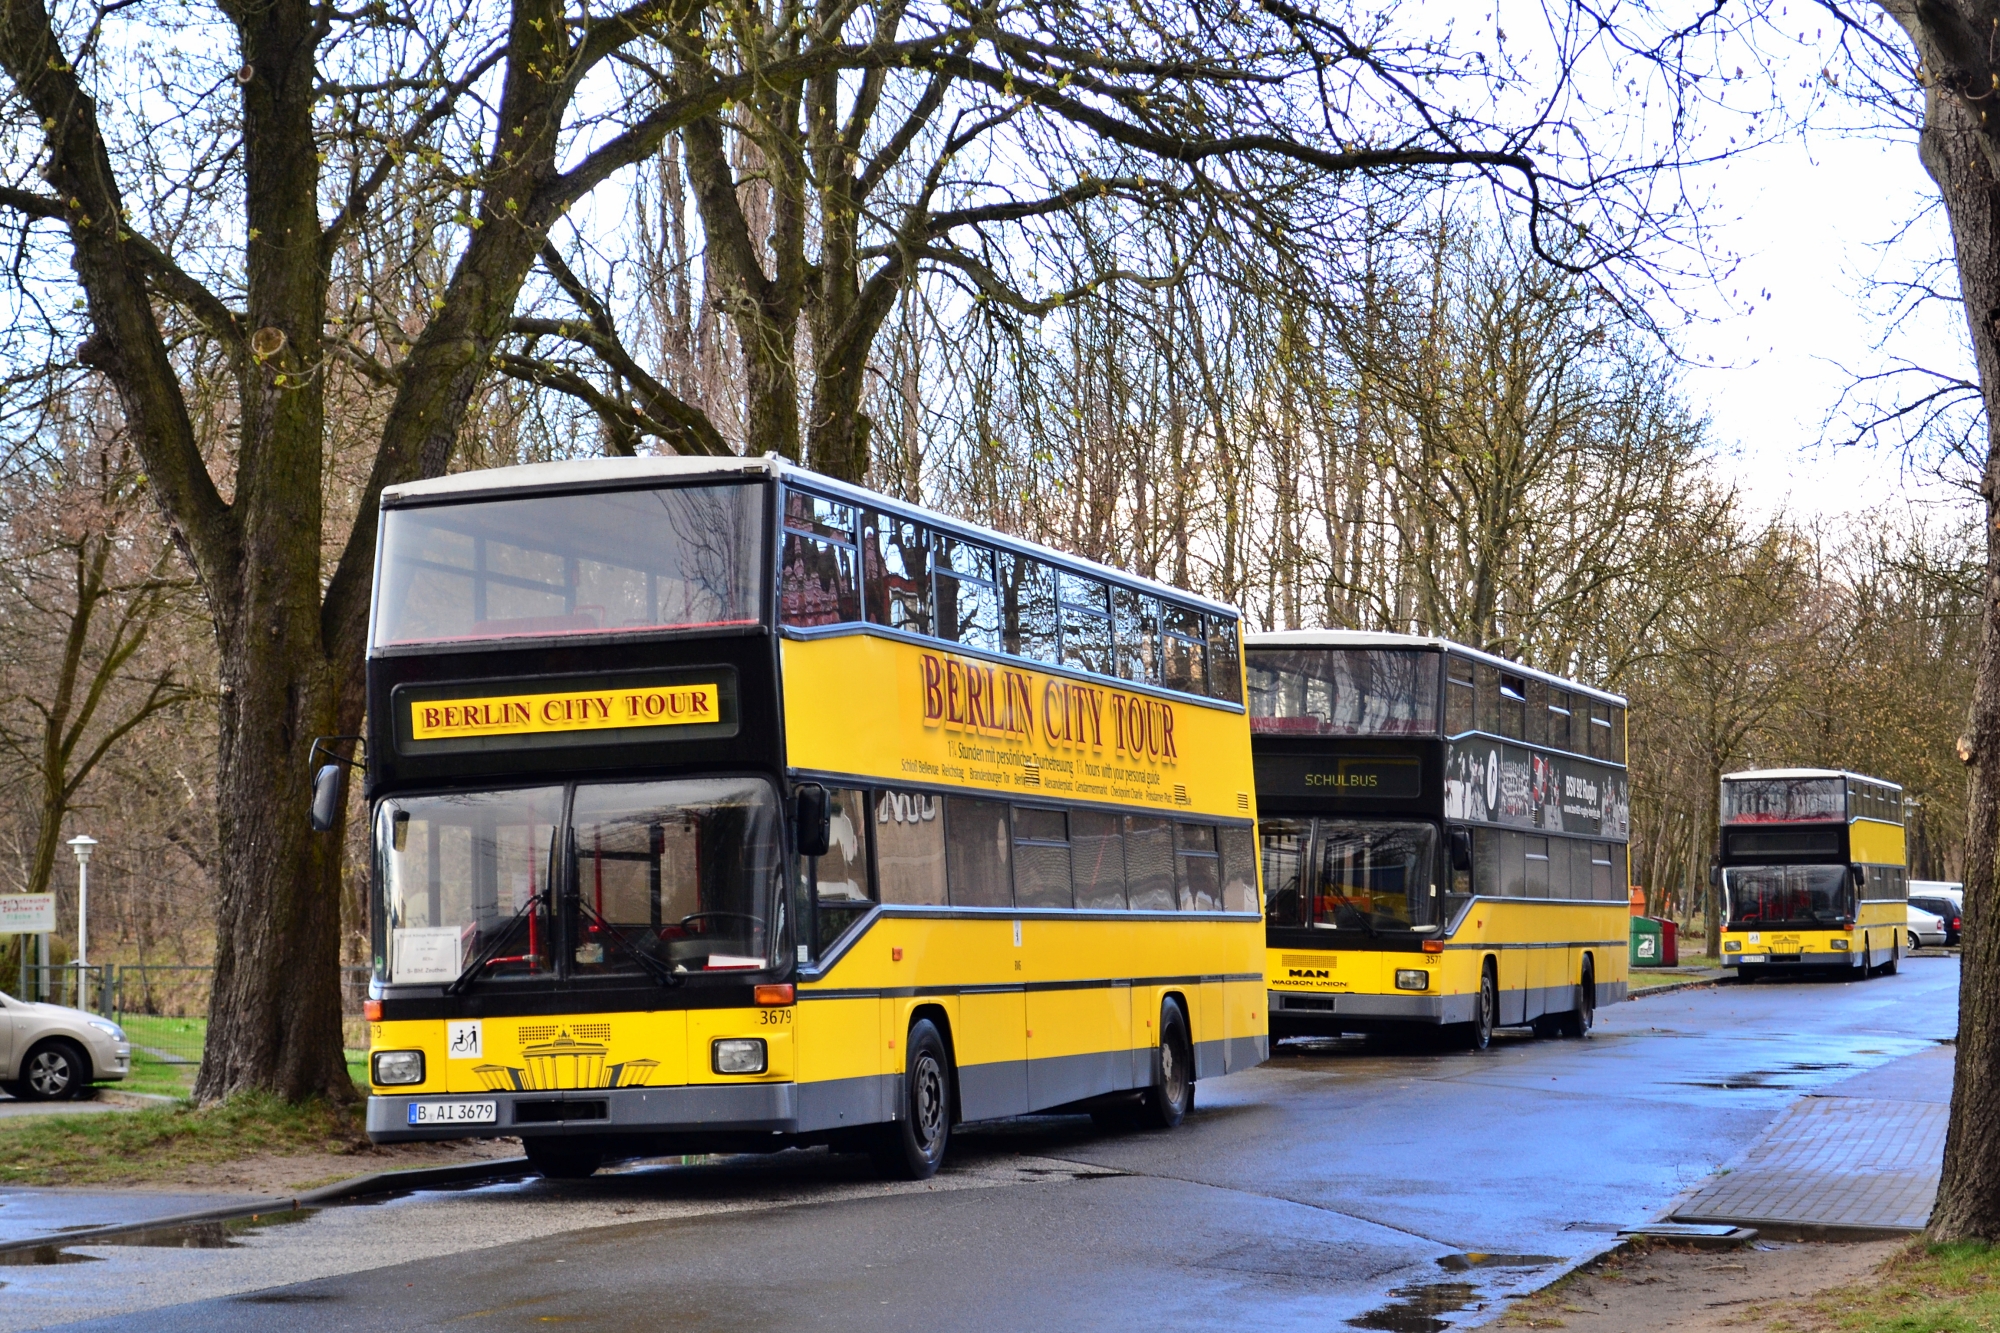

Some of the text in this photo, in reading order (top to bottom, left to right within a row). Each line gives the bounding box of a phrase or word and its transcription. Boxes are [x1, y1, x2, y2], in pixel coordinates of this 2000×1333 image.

[423, 691, 710, 731] BERLIN CITY TOUR
[921, 654, 1178, 764] BERLIN CITY TOUR
[958, 742, 984, 762] Stunden
[985, 746, 996, 763] mit
[996, 748, 1032, 768] persönlicher
[1033, 753, 1074, 778] Tourbetreuung
[1085, 760, 1100, 777] hours
[1101, 763, 1113, 779] with
[1113, 767, 1125, 784] your
[1125, 769, 1147, 785] personal
[1147, 770, 1160, 788] guide
[918, 760, 939, 775] Bellevue
[941, 764, 965, 782] Reichstag
[969, 768, 1002, 786] Brandenburger
[1044, 777, 1073, 794] Alexanderplatz
[1110, 784, 1130, 801] Checkpoint
[1130, 786, 1143, 800] Charlie
[1304, 774, 1378, 787] SCHULBUS
[1583, 779, 1597, 806] Rugby
[1425, 955, 1441, 965] 3577
[1289, 969, 1329, 978] MAN
[760, 1009, 791, 1025] 3679
[418, 1104, 493, 1120] B AI 3679
